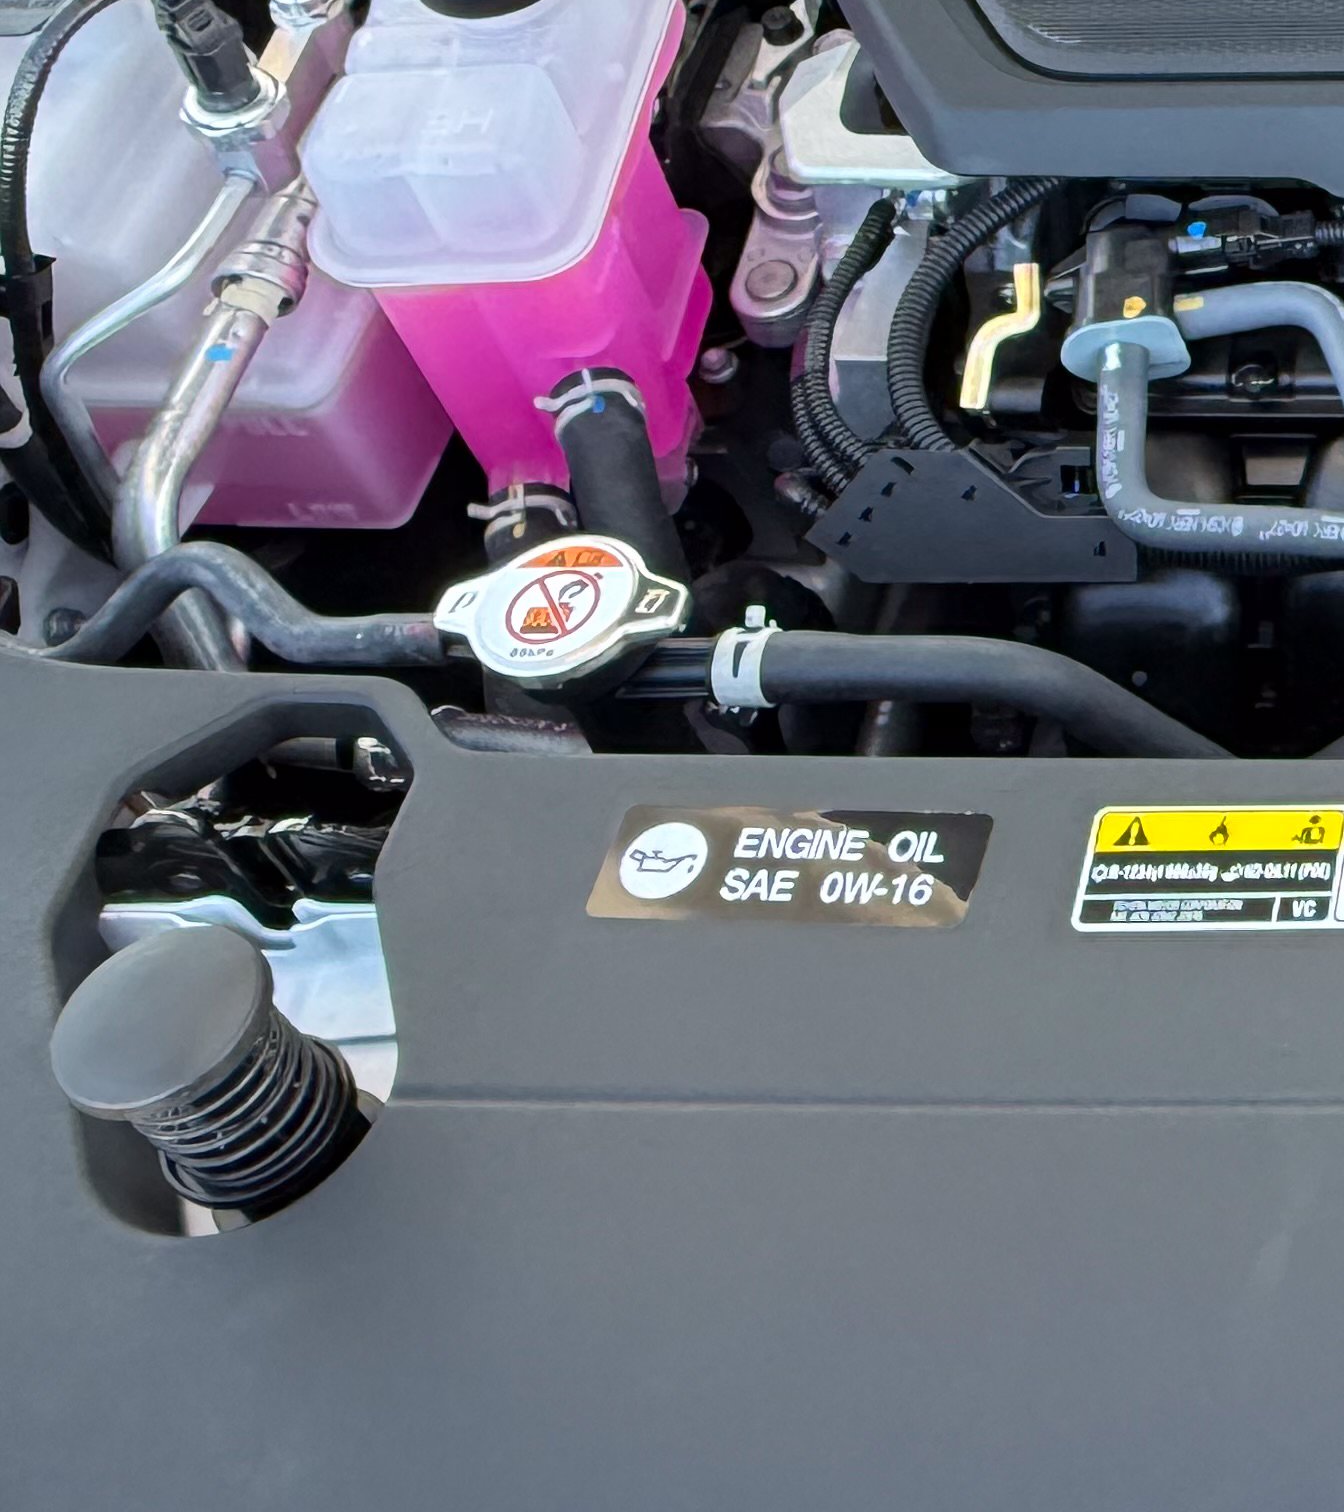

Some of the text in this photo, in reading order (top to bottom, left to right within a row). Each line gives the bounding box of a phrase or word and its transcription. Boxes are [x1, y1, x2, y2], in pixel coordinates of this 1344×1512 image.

[733, 826, 944, 863] ENGINE OIL
[719, 867, 935, 906] SAE 0W-16
[1291, 899, 1317, 918] VC
